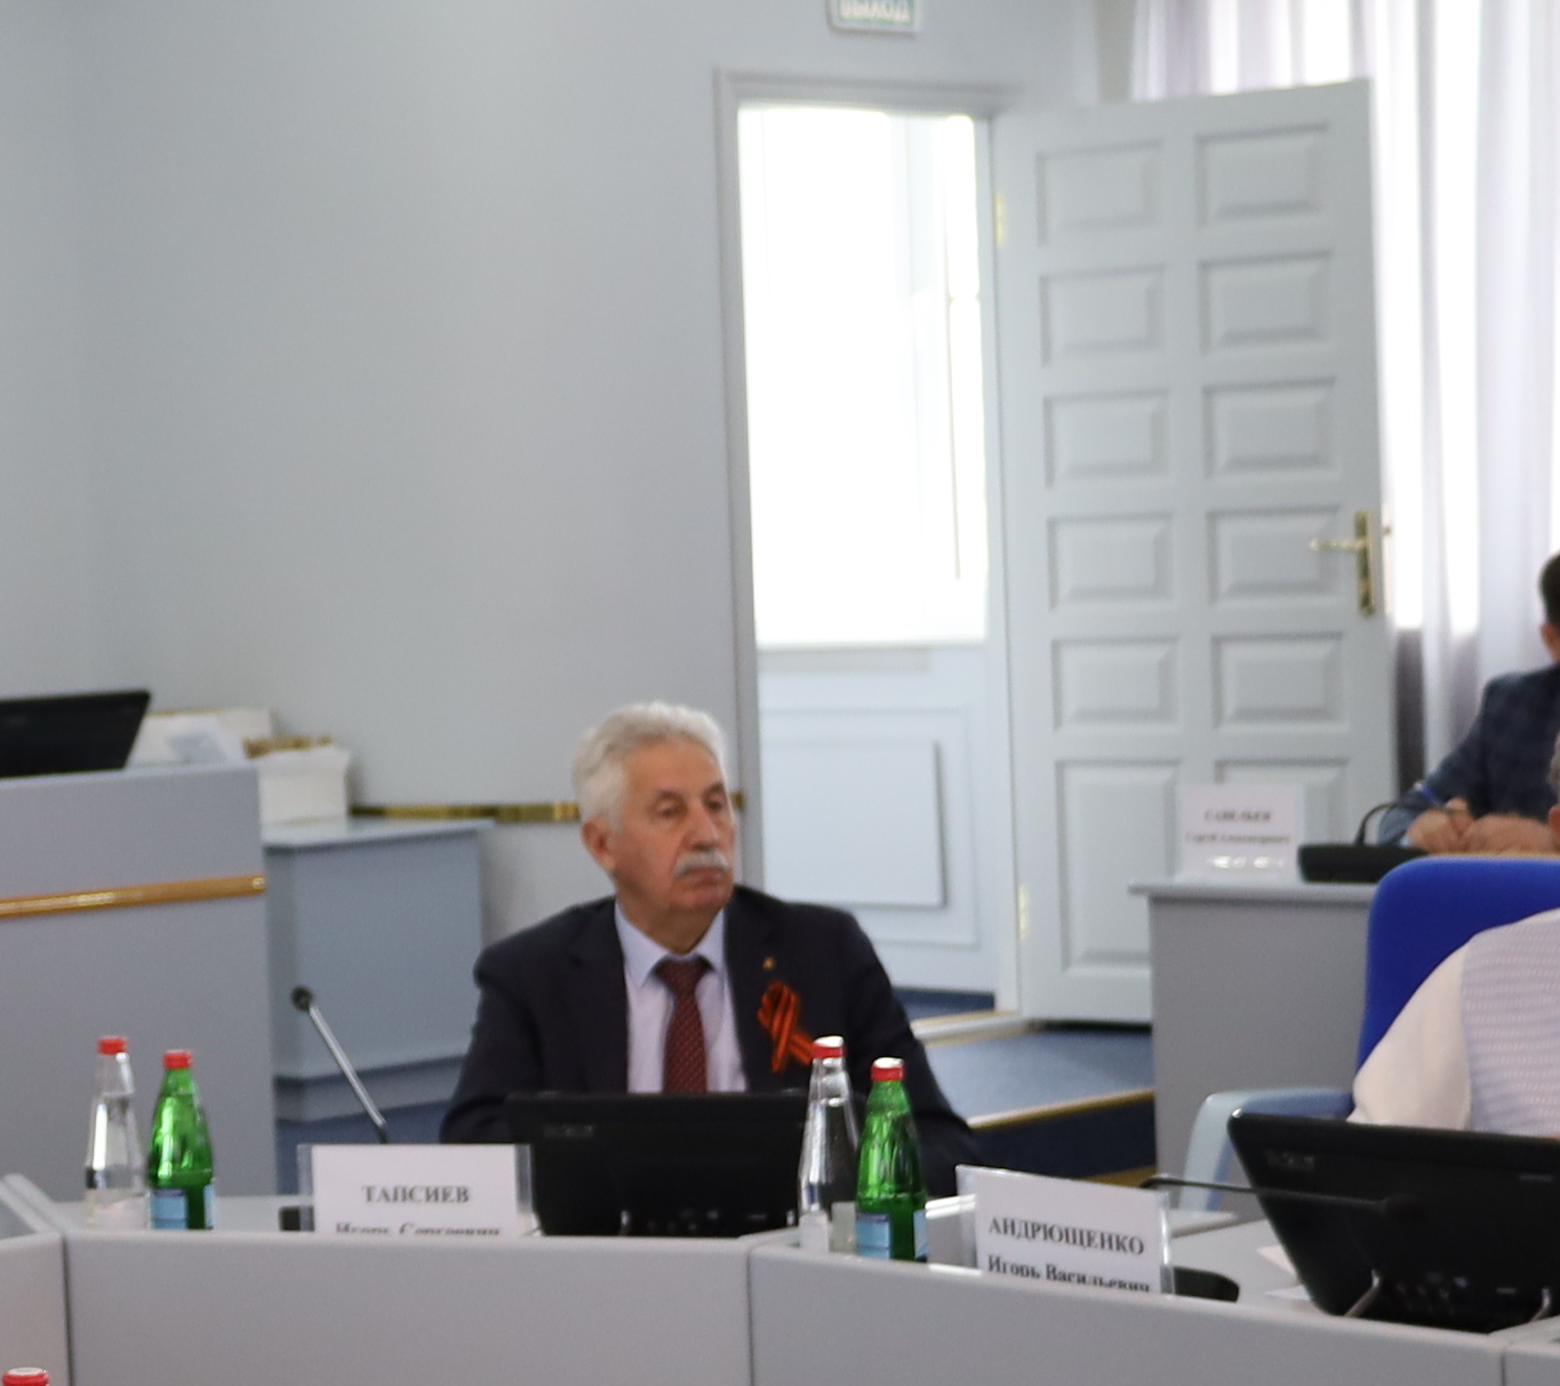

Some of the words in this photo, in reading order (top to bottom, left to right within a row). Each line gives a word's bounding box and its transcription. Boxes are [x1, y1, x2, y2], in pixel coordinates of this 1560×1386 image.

[362, 1184, 471, 1204] ТАПСИЕВ
[989, 1217, 1145, 1256] АНДРЮЩЕНКО
[987, 1254, 1041, 1280] Игорь
